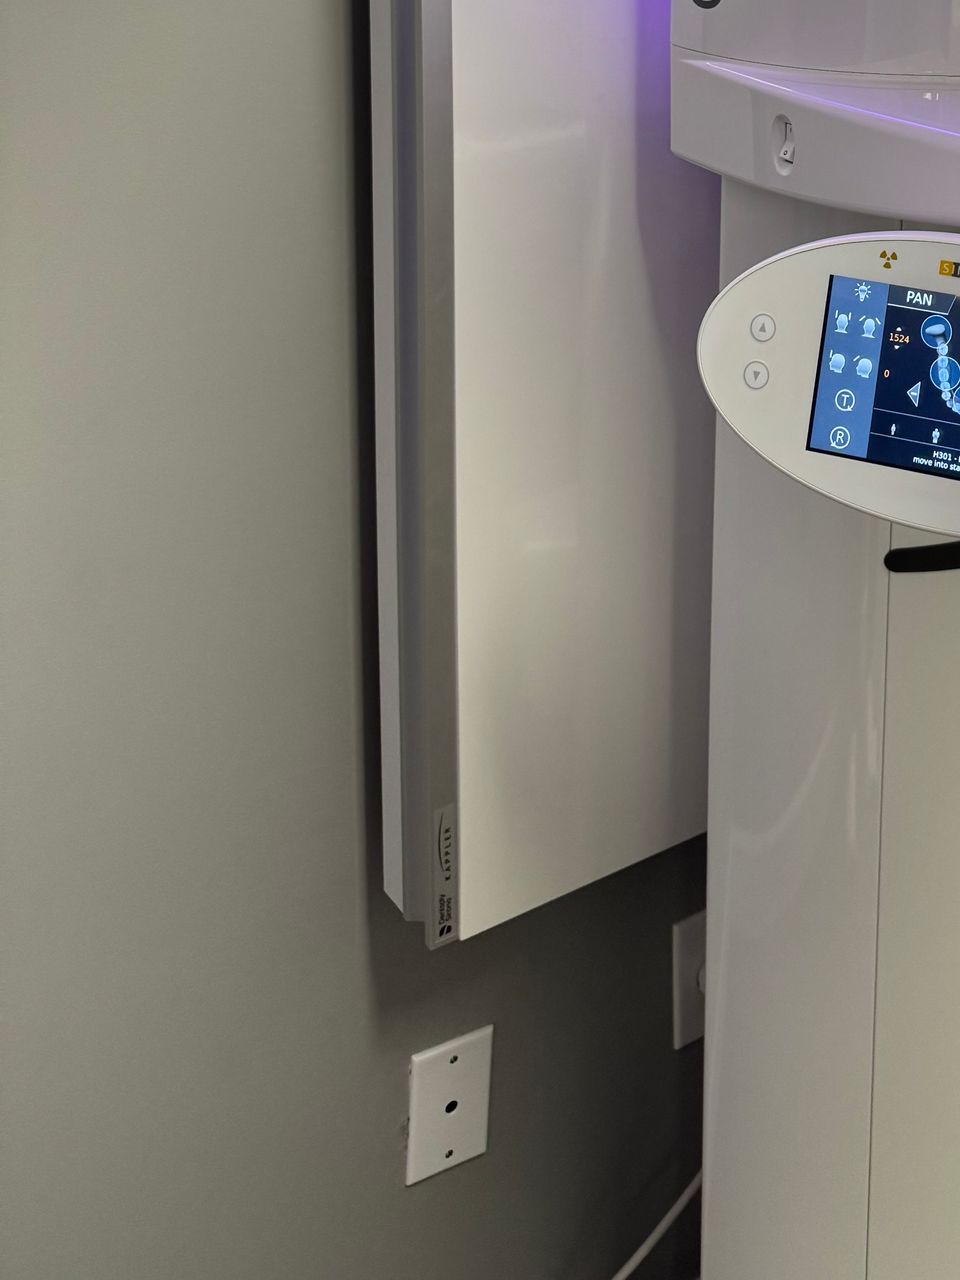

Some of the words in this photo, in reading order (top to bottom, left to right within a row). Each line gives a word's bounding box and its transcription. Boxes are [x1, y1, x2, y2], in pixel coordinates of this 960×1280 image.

[906, 290, 933, 307] PAN
[889, 332, 910, 344] 1524
[933, 450, 952, 461] H301
[912, 456, 933, 466] move
[934, 459, 949, 470] into
